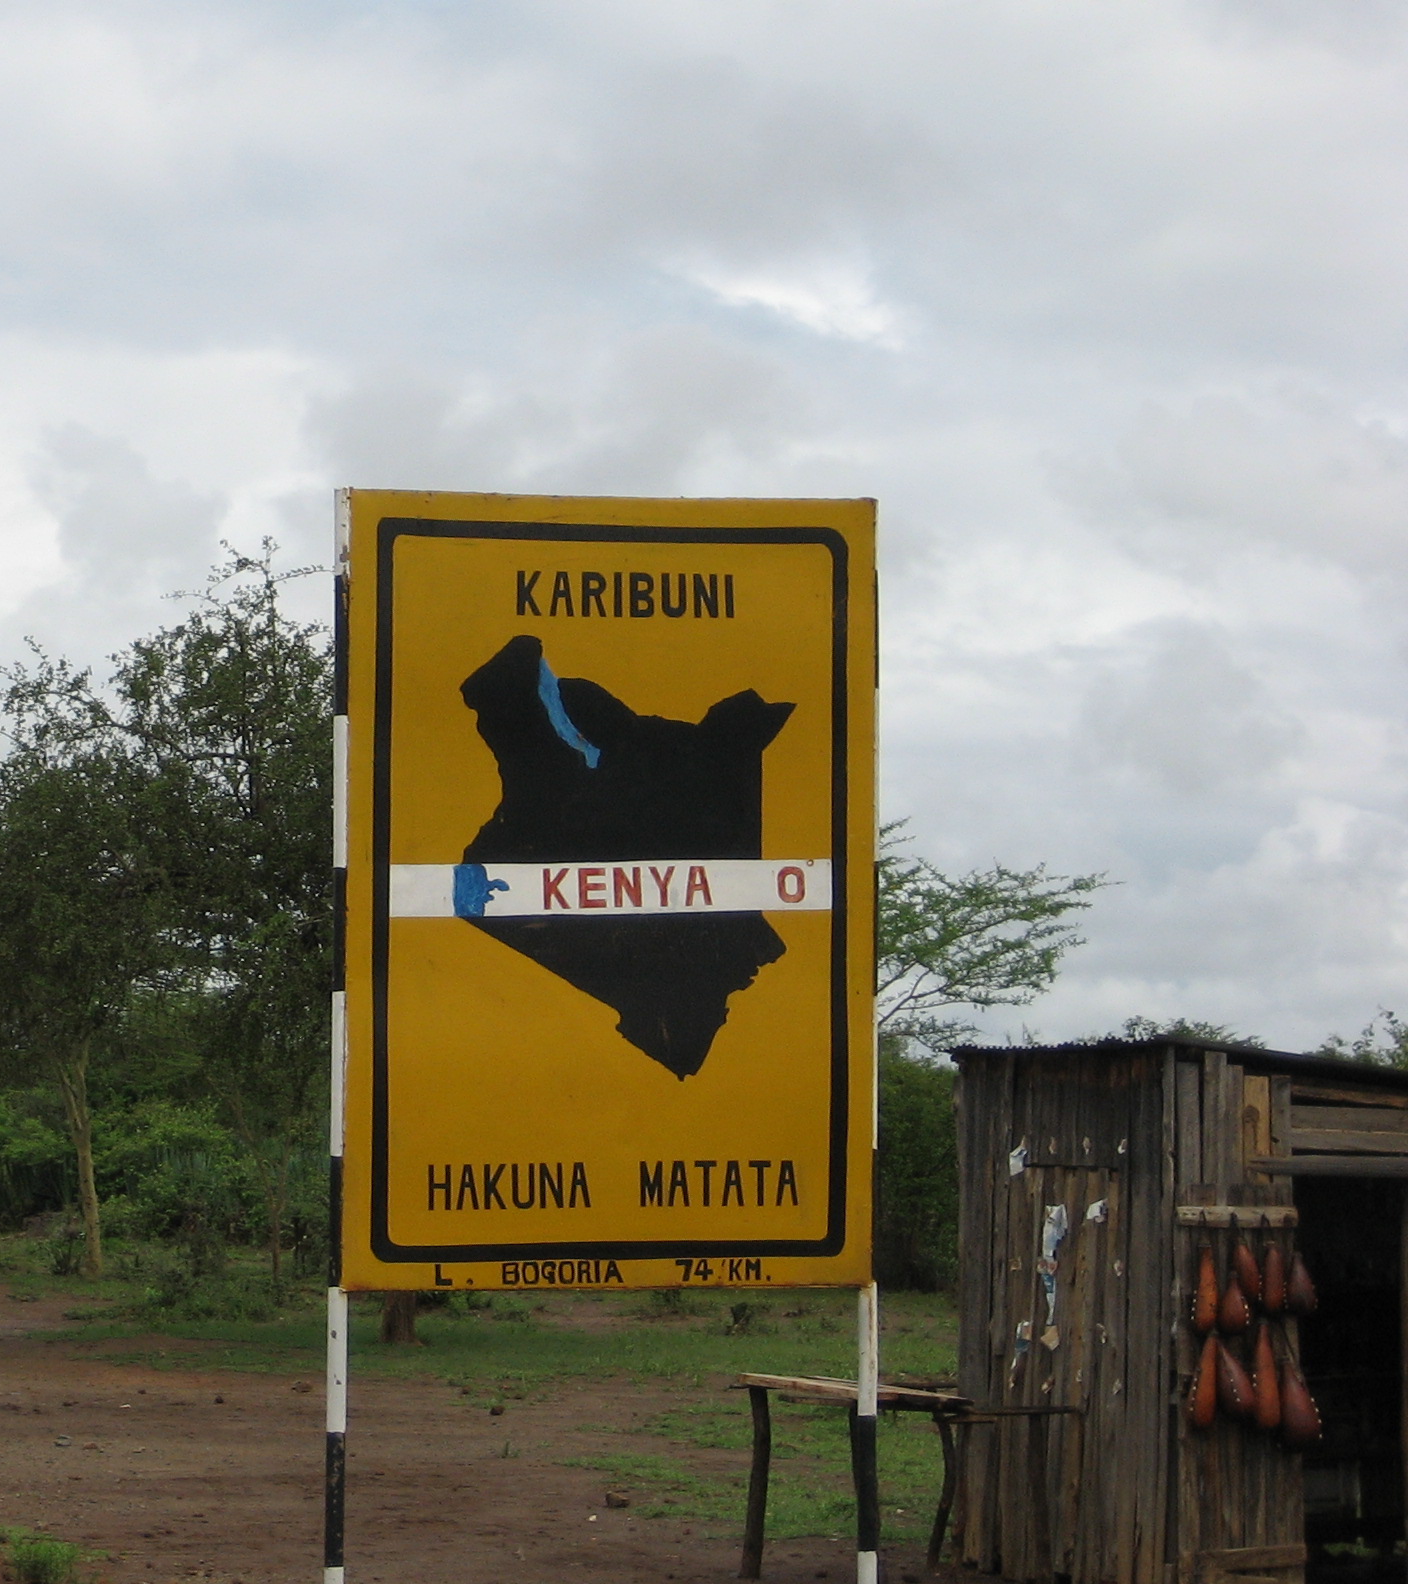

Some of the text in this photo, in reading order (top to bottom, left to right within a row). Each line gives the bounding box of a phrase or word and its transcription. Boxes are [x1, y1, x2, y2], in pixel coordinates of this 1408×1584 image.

[516, 570, 735, 619] KARIBUNI
[542, 865, 713, 911] KENYA
[427, 1160, 800, 1211] HAKUNA MATATA
[502, 1260, 624, 1286] BOGORIA
